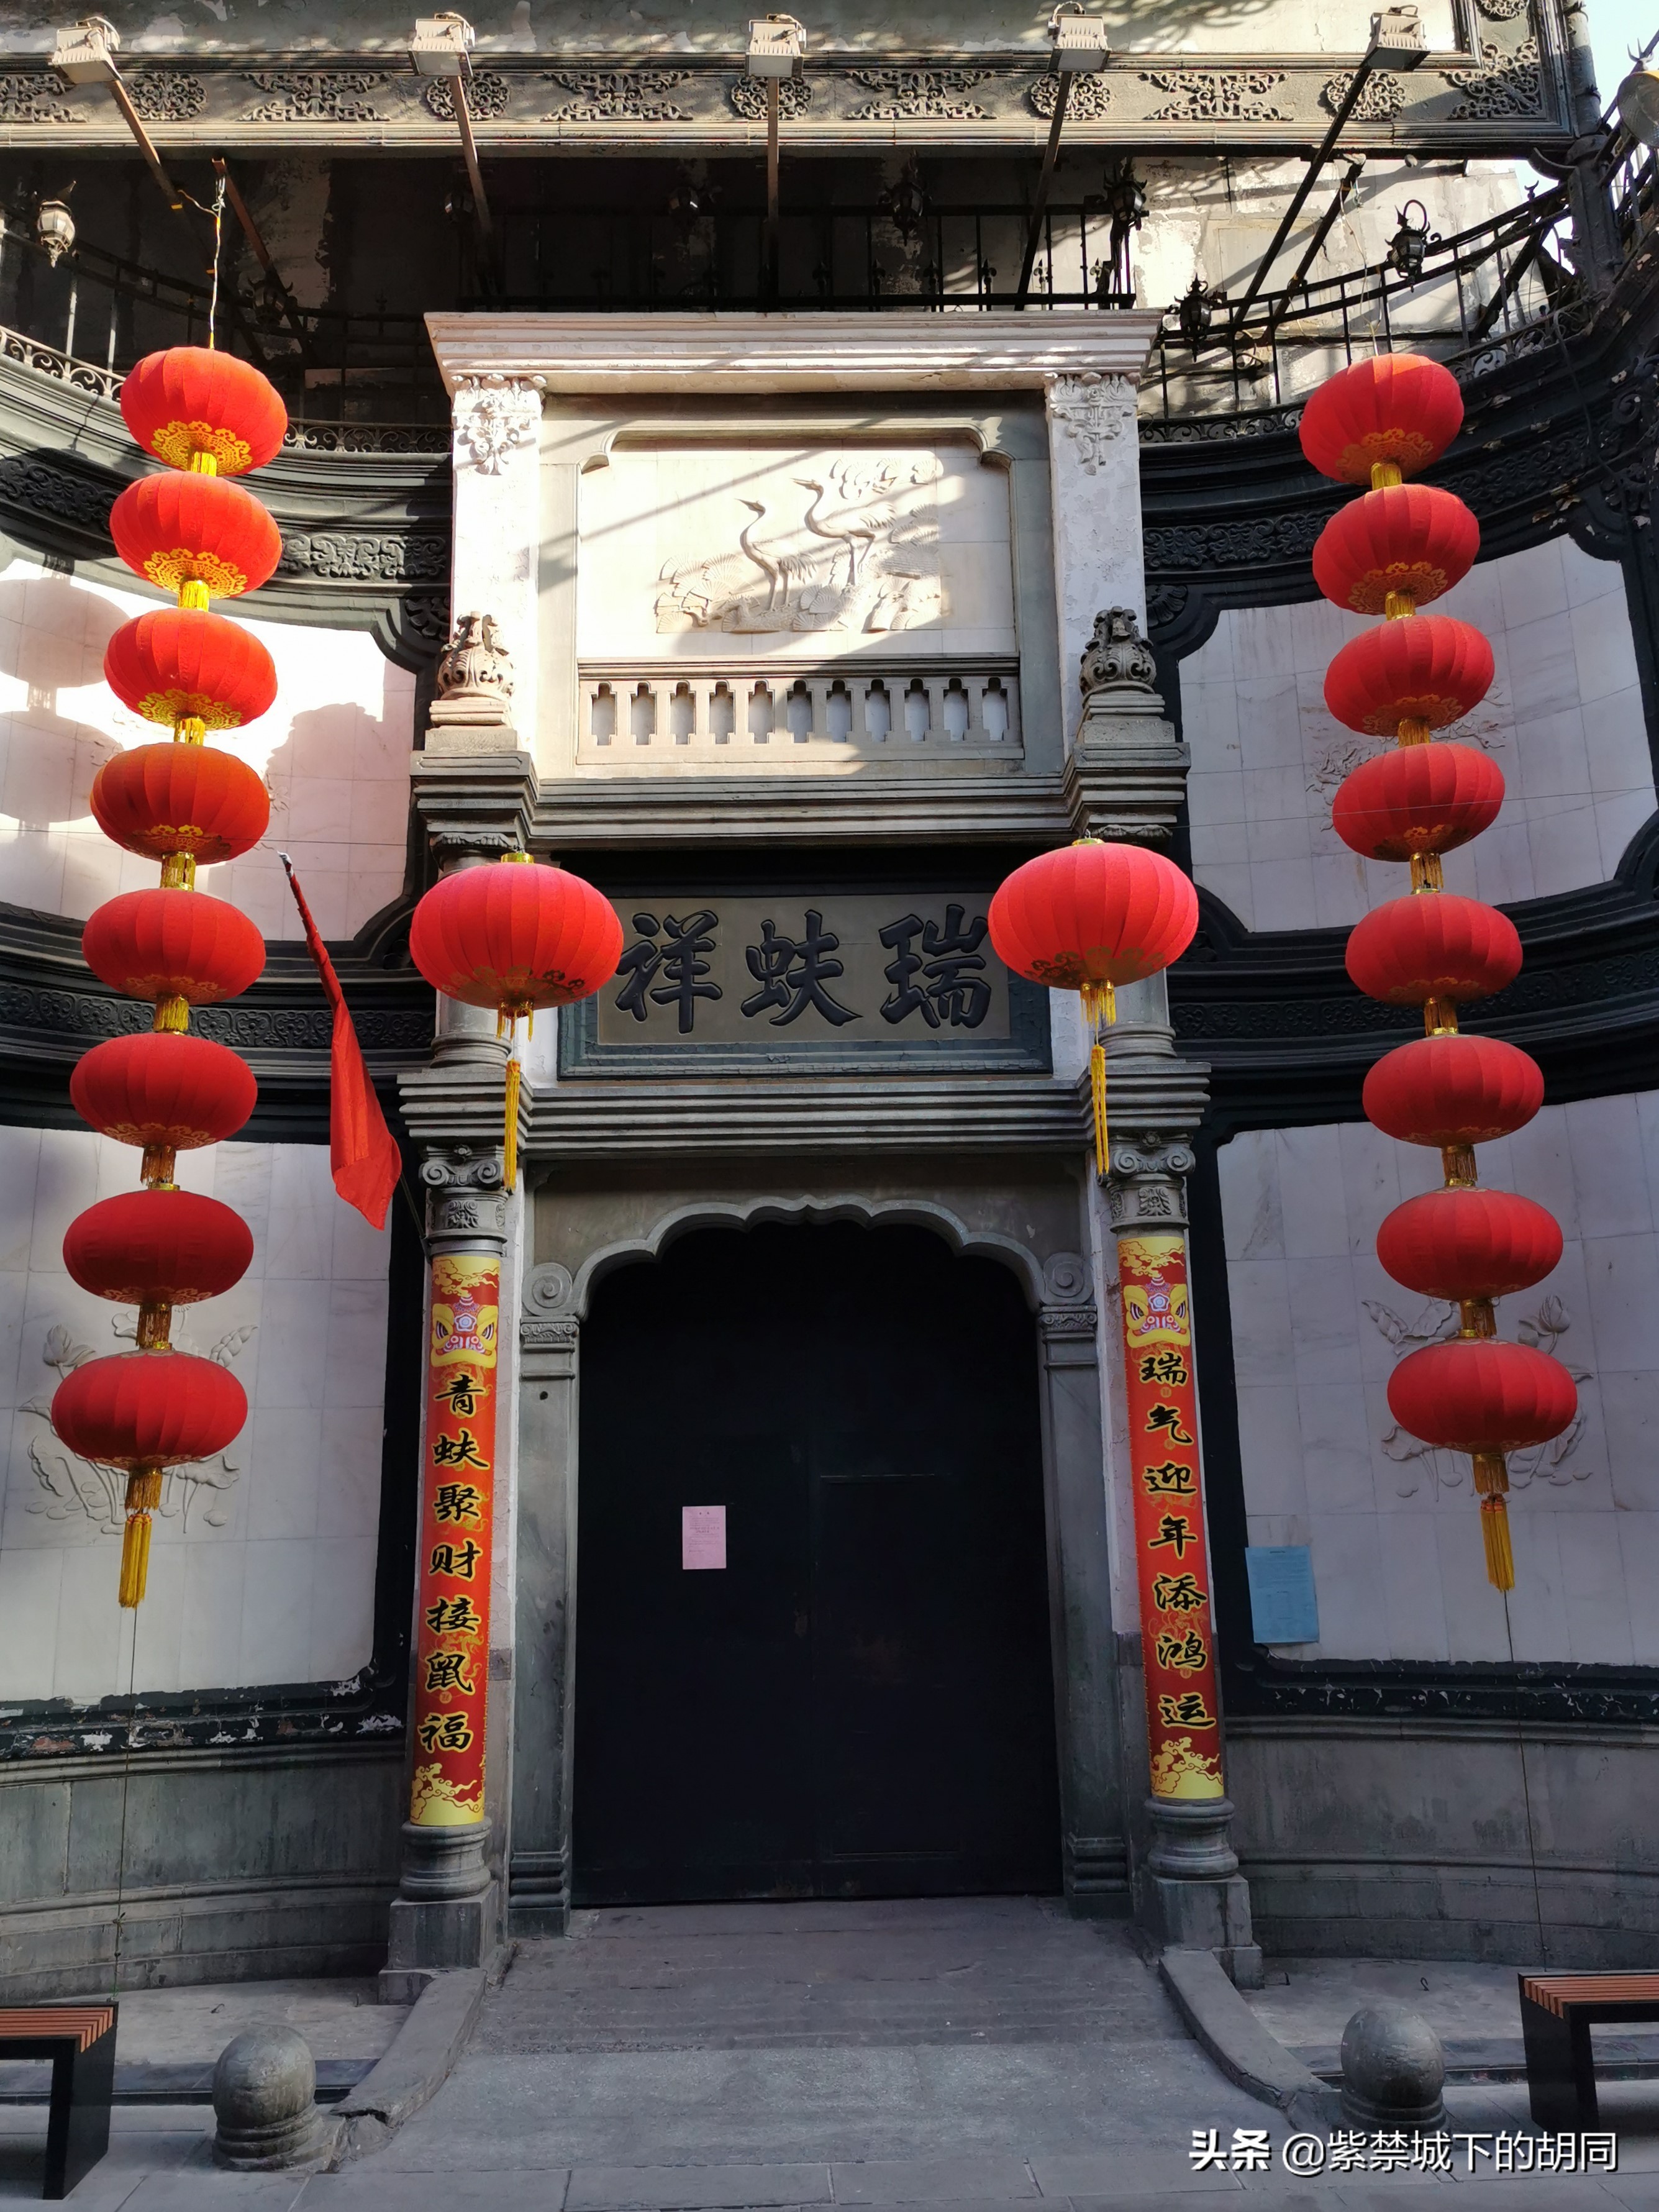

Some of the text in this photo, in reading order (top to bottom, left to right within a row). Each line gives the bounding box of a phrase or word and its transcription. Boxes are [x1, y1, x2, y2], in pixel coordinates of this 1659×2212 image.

[419, 1374, 489, 1752] 青蚨聚财接鼠福
[1140, 1352, 1216, 1728] 瑞气迎年添鸿运
